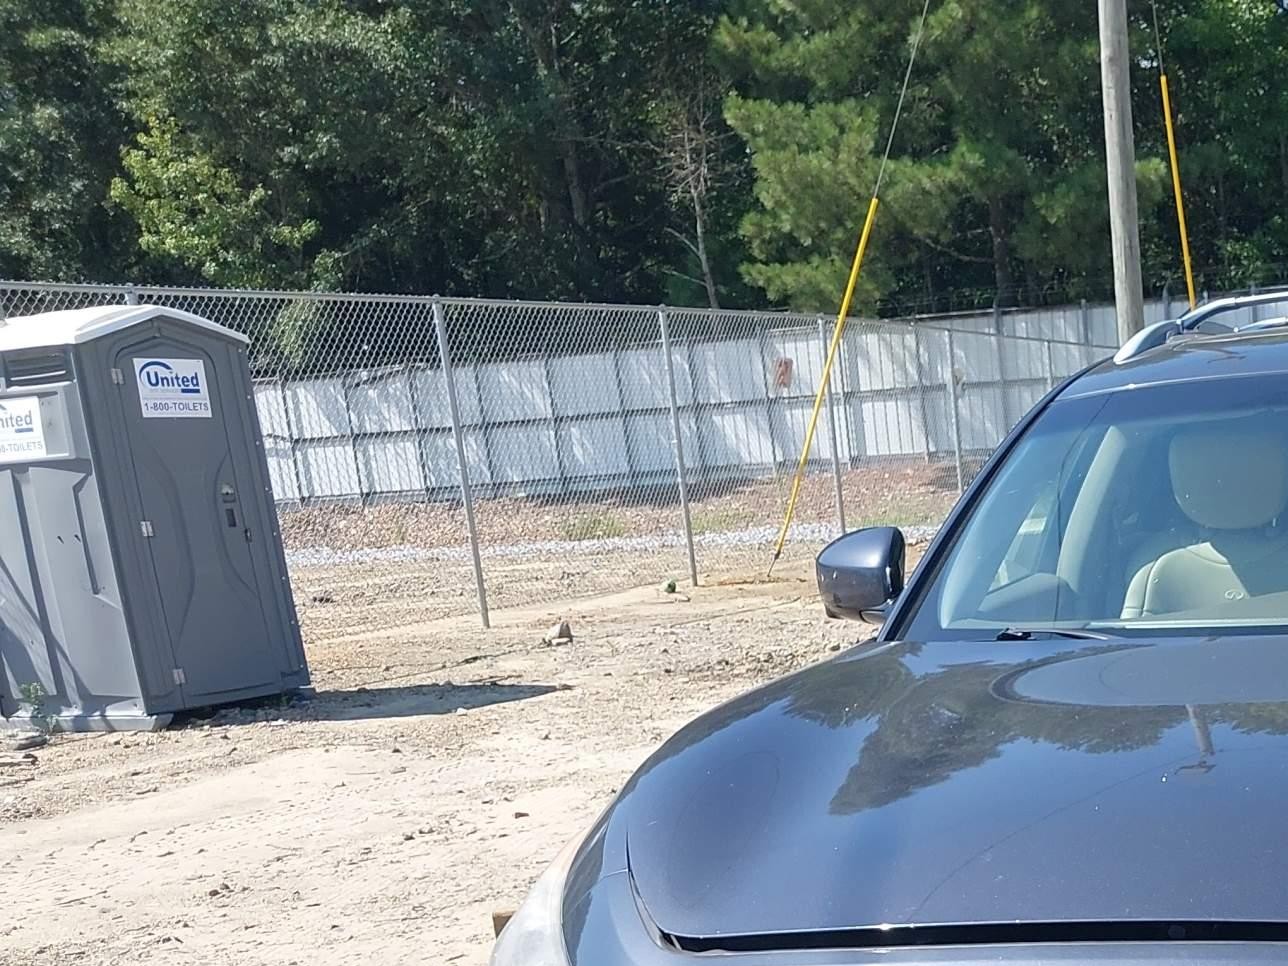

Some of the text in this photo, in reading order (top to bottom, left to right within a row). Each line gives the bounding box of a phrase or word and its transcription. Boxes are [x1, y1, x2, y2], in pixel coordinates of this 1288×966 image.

[146, 371, 200, 387] United
[144, 402, 209, 411] 1-800-TOILETS
[0, 409, 33, 428] nited
